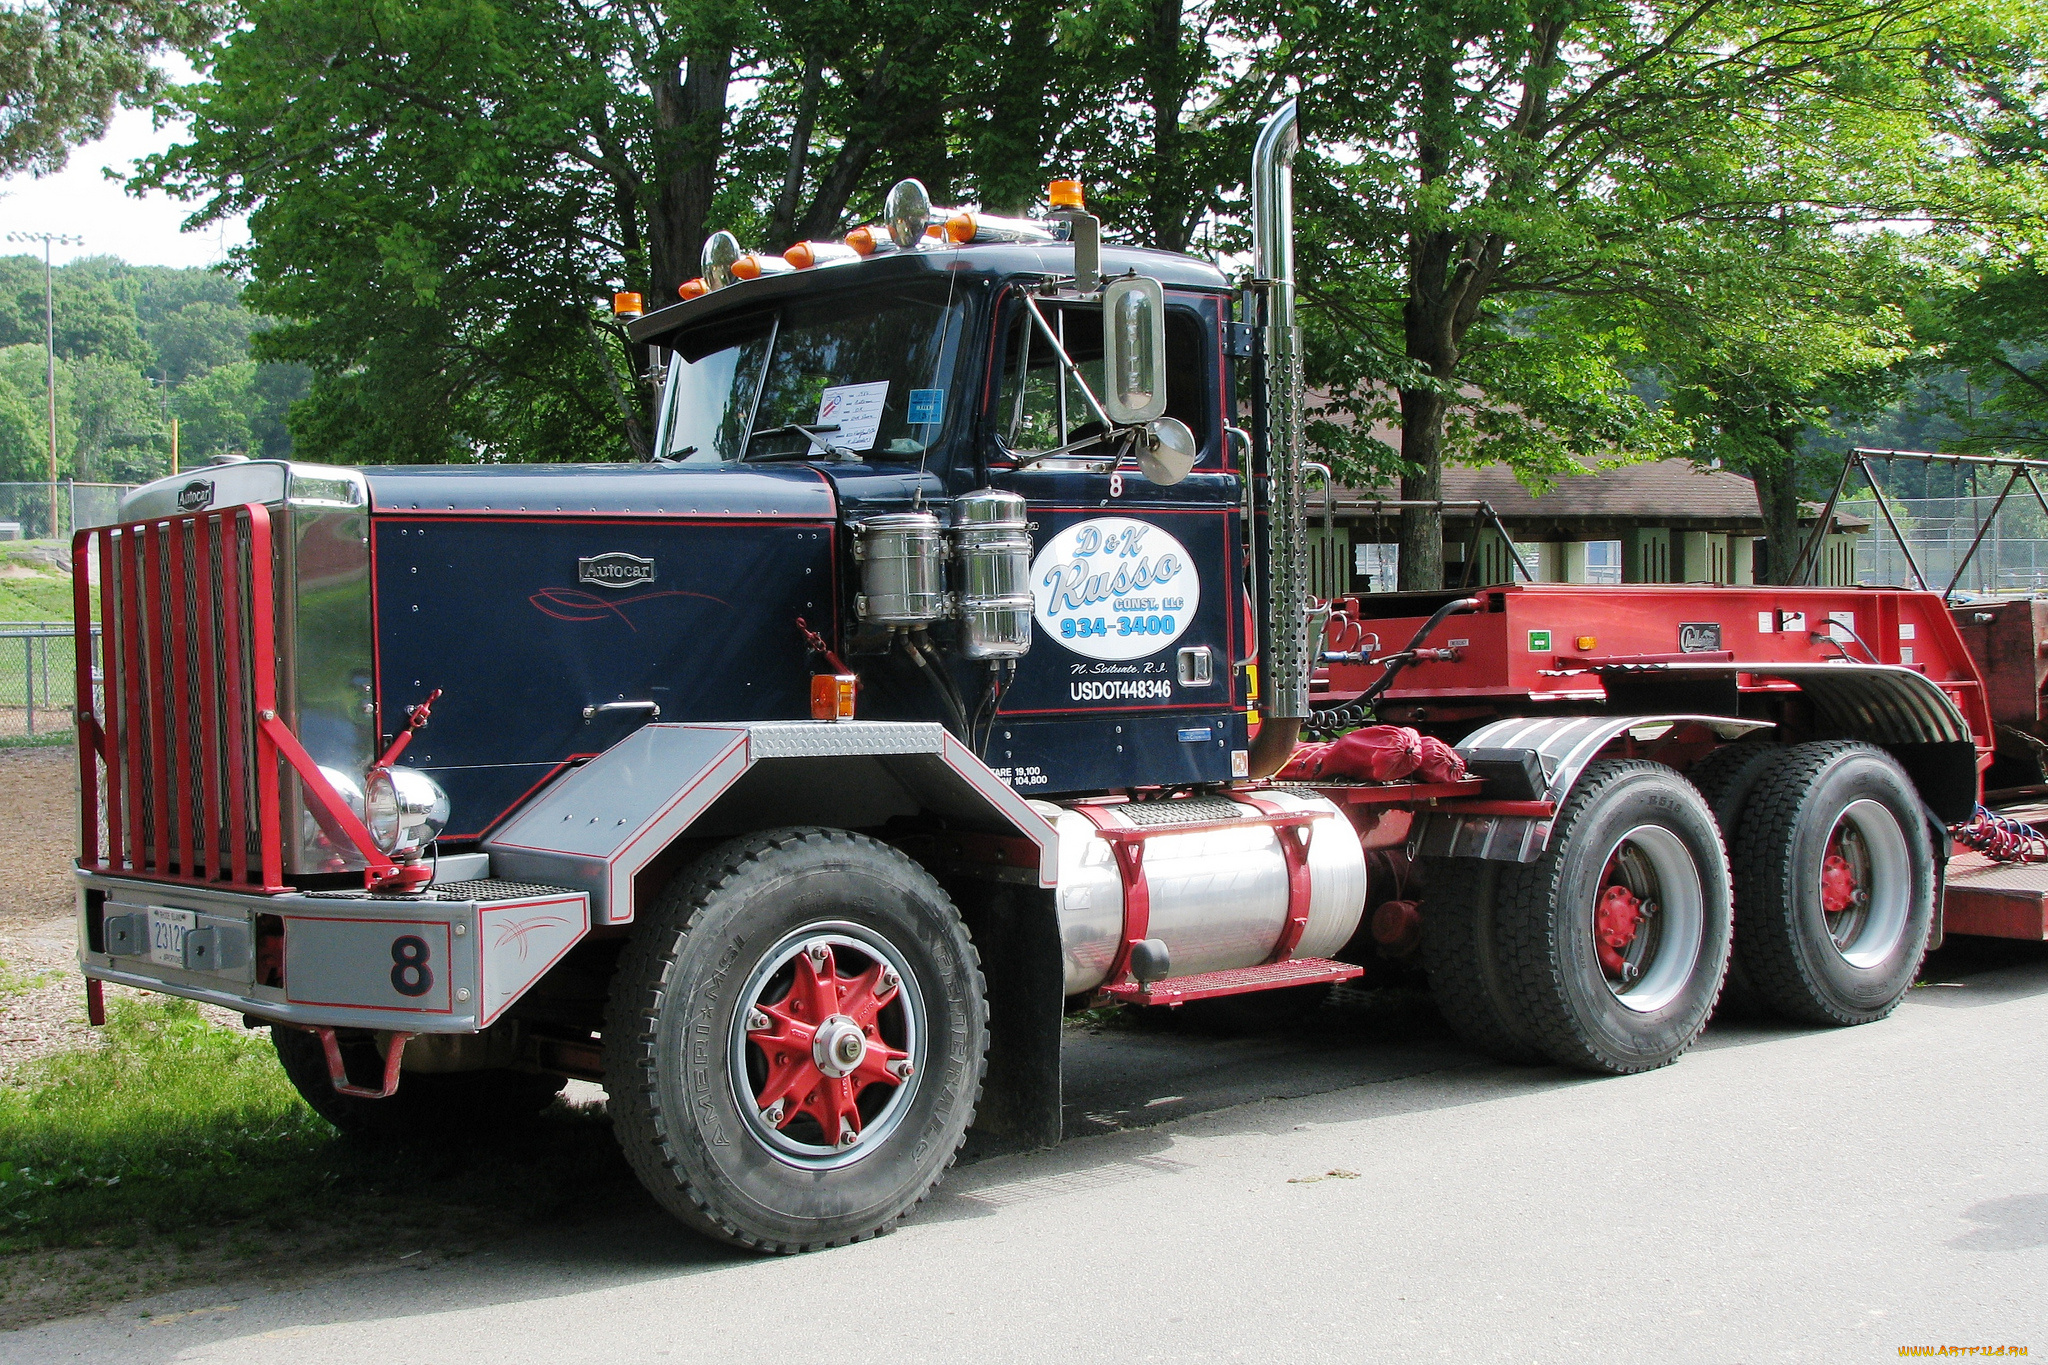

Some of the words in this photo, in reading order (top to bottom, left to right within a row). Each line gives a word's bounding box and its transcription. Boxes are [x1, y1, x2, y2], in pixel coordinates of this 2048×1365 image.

[1109, 474, 1123, 498] 8
[179, 490, 210, 505] Autocar
[585, 563, 649, 578] Autocar
[1043, 553, 1182, 617] Russo
[1113, 597, 1159, 612] CONST.
[1162, 596, 1184, 611] LLC
[1060, 614, 1175, 639] 934-3400
[1070, 663, 1088, 675] N.
[1143, 662, 1168, 674] R.I.
[1070, 679, 1172, 701] USDOT448346
[1014, 766, 1041, 777] 19,100
[1014, 775, 1048, 786] 104,800
[390, 935, 434, 998] 8
